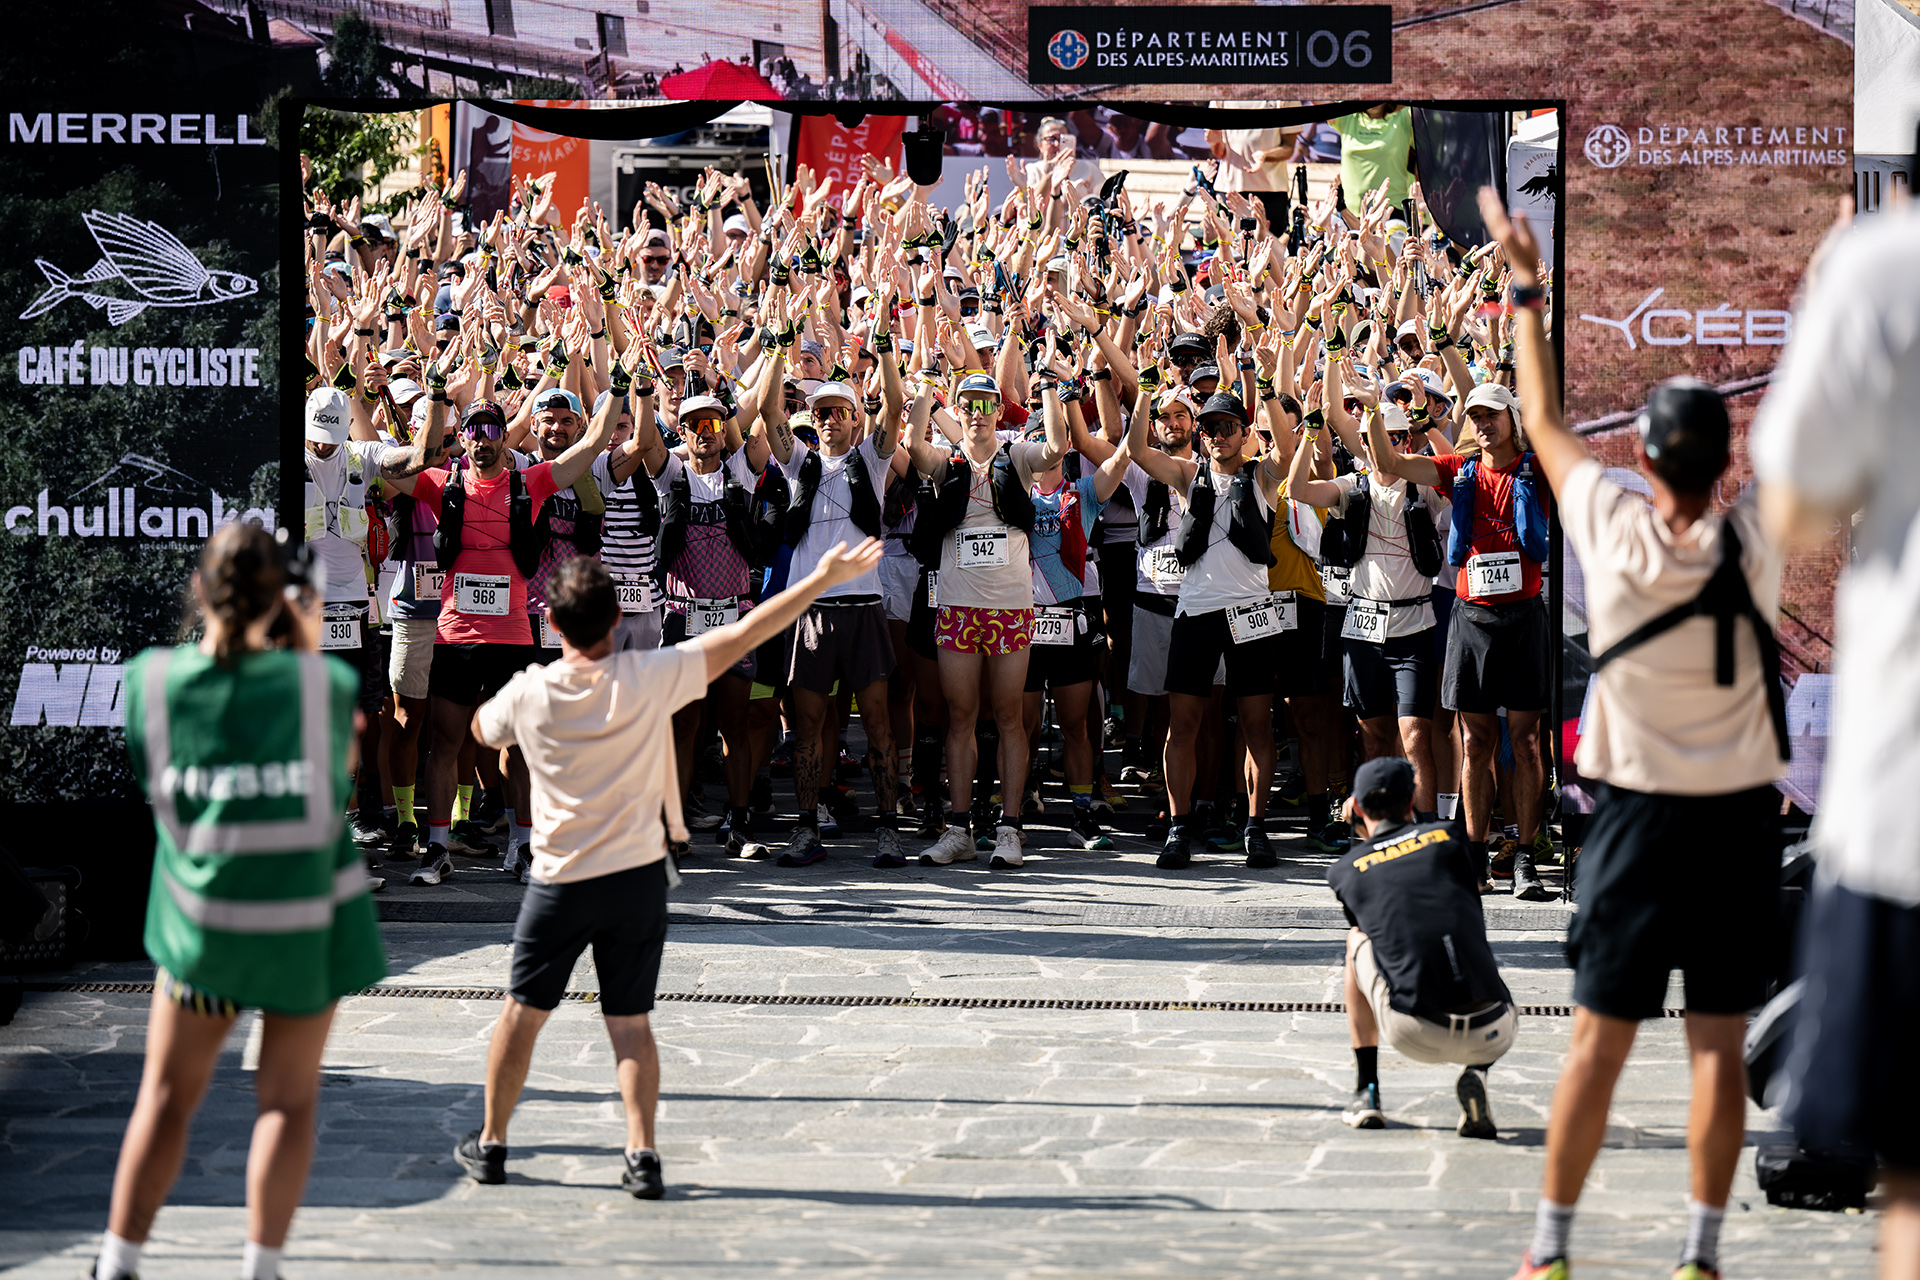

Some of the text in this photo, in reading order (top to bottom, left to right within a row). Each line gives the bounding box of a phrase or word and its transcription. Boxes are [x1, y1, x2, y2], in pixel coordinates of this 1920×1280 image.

[1097, 28, 1289, 48] DÉPARTEMENT
[1306, 30, 1373, 68] 06
[1097, 53, 1289, 67] DES ALPES-MARITIMES
[9, 113, 267, 144] MERRELL
[1638, 123, 1847, 145] DÉPARTEMENT
[1638, 150, 1847, 165] DES ALPES-MARITIMES
[18, 339, 259, 386] CAFÉ DU CYCLISTE
[313, 413, 339, 425] HOKA
[972, 541, 994, 556] 942
[1481, 567, 1509, 584] 1244
[473, 589, 495, 604] 968
[617, 588, 642, 603] 1286
[705, 612, 725, 627] 922
[1248, 611, 1269, 629] 908
[1353, 613, 1378, 630] 1029
[331, 624, 351, 638] 930
[1036, 621, 1061, 635] 1279
[26, 646, 121, 664] Powered by
